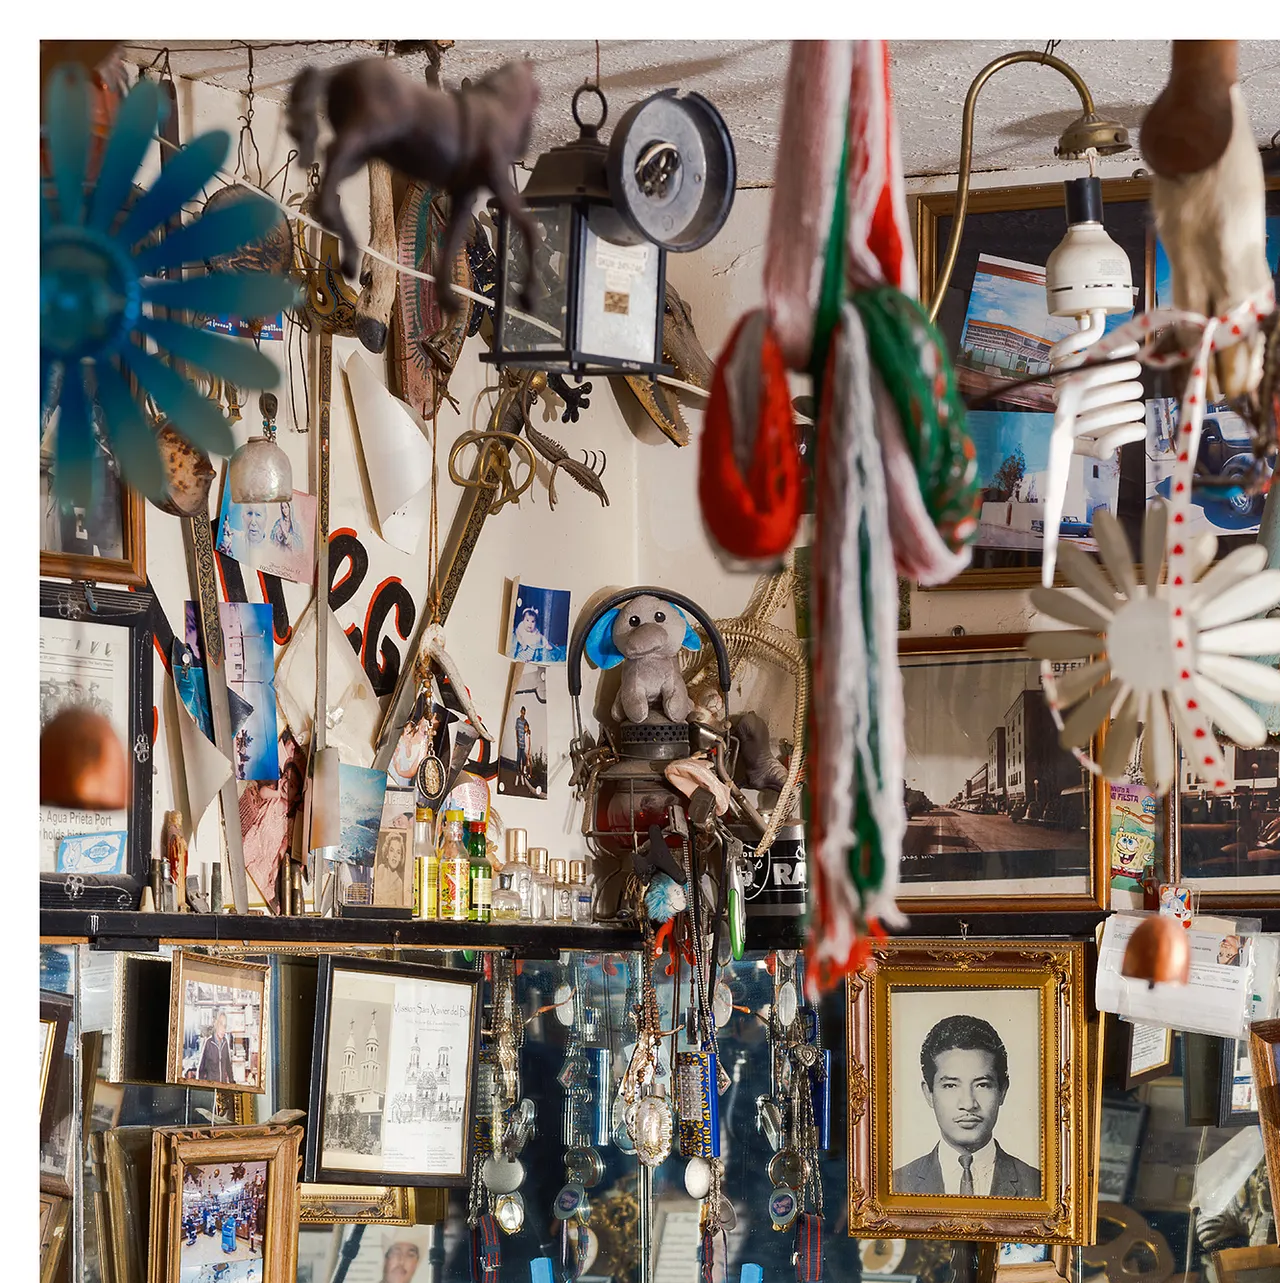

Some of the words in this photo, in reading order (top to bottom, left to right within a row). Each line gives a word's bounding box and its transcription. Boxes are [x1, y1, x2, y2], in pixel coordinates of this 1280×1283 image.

[47, 811, 68, 825] Agua
[69, 812, 93, 825] Prieta
[95, 813, 112, 827] Port
[43, 828, 65, 840] holds
[416, 1002, 429, 1016] San
[430, 1003, 450, 1016] Xavier
[450, 1004, 459, 1015] del
